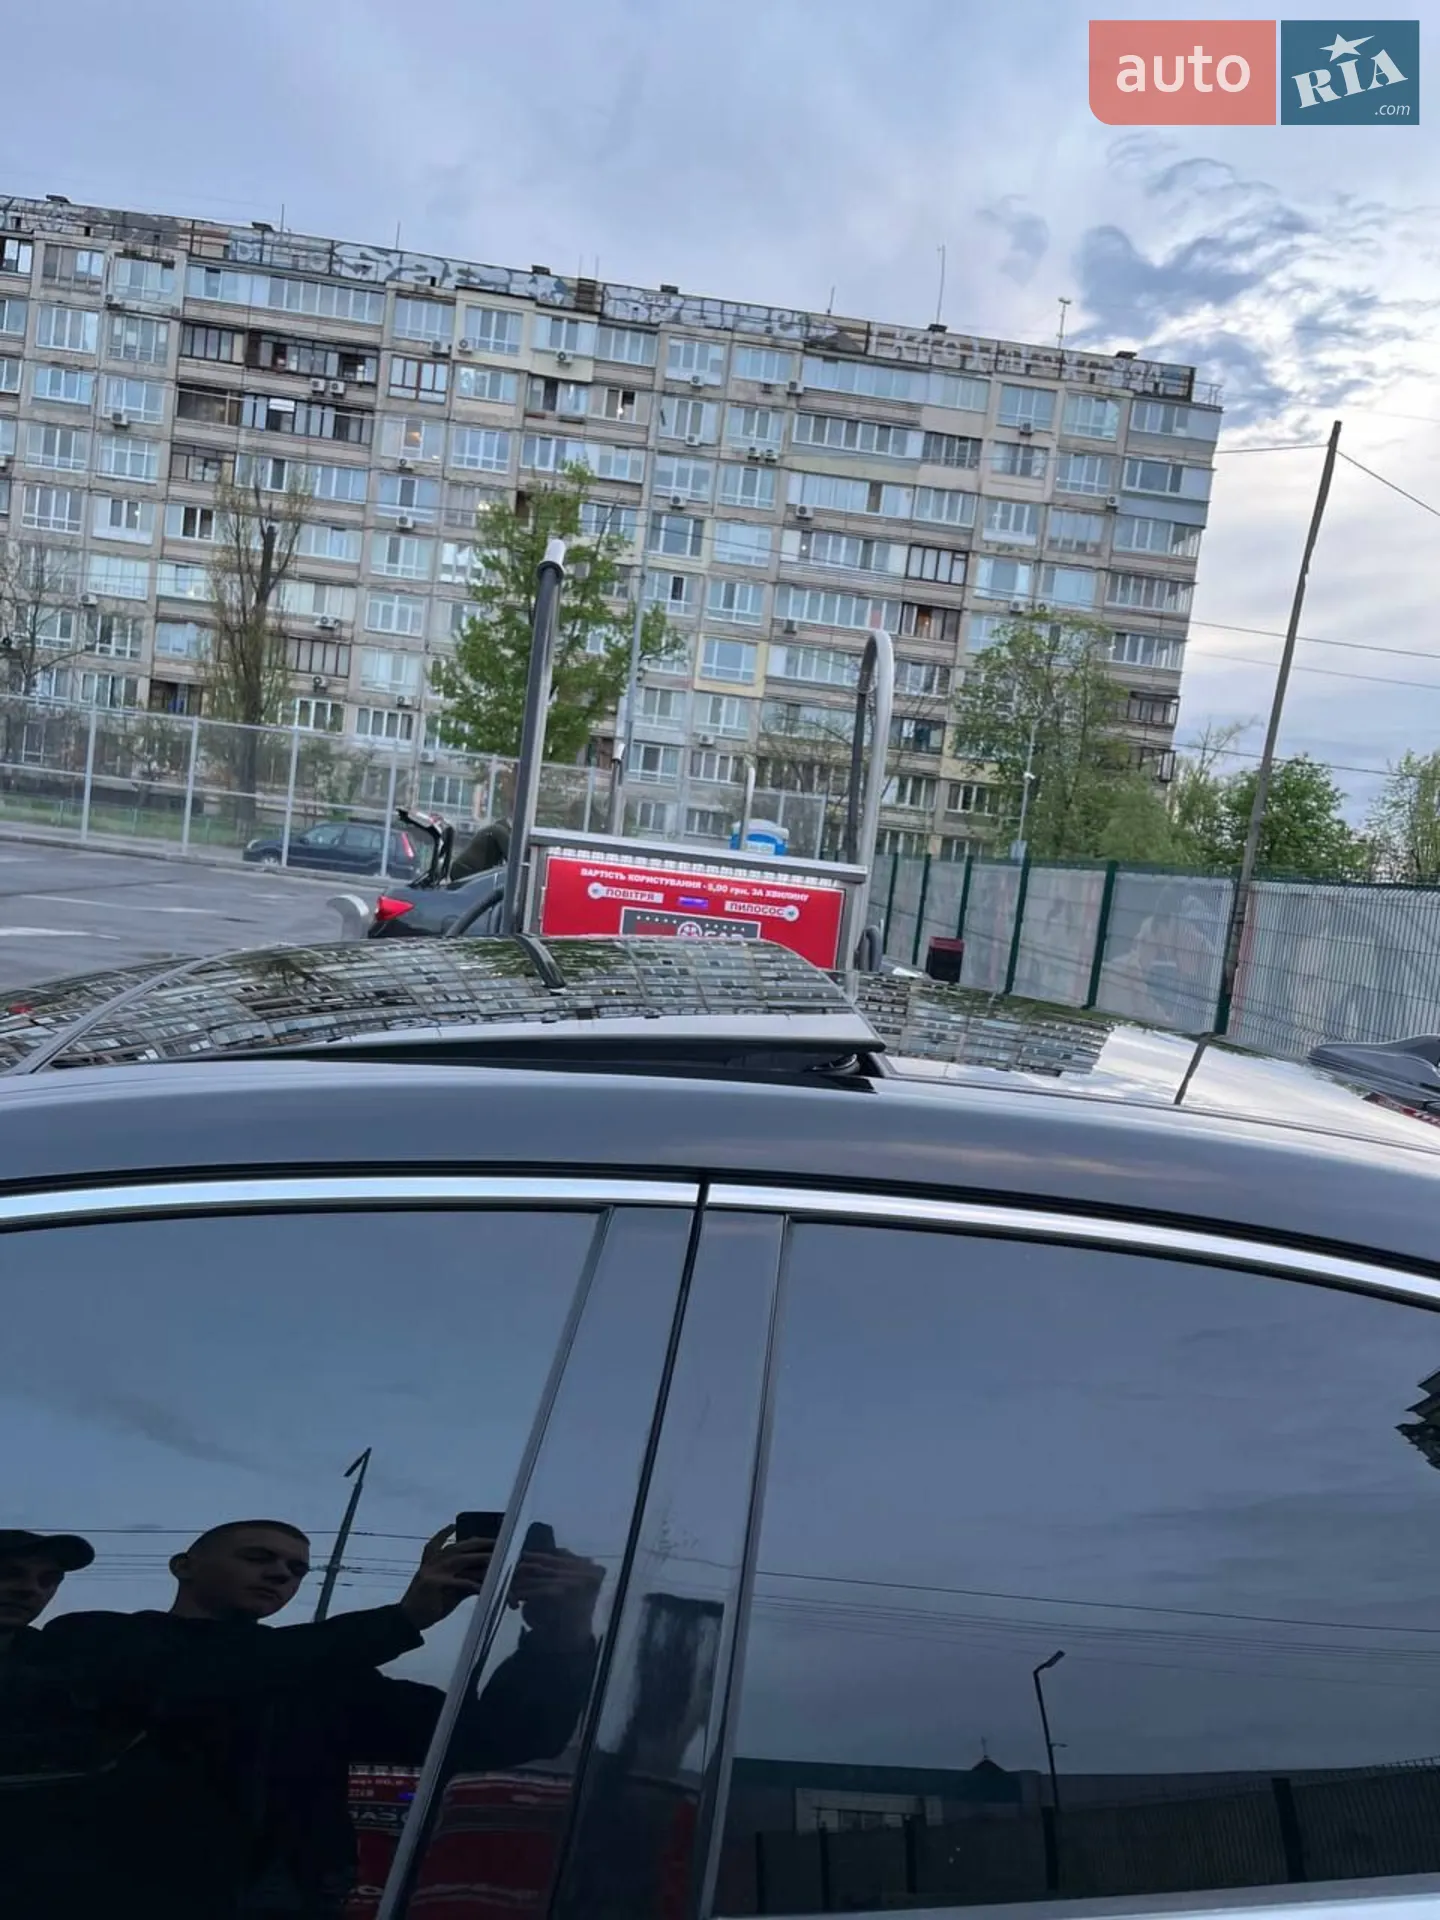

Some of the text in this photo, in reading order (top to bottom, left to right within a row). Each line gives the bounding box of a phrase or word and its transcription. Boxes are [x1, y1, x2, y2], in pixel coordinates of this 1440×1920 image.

[581, 868, 626, 880] ВАРТІСТЬ
[628, 873, 702, 889] КОРИСТУВАННЯ
[605, 888, 655, 901] ПОВІТРЯ
[730, 902, 784, 915] ПИЛОСОС
